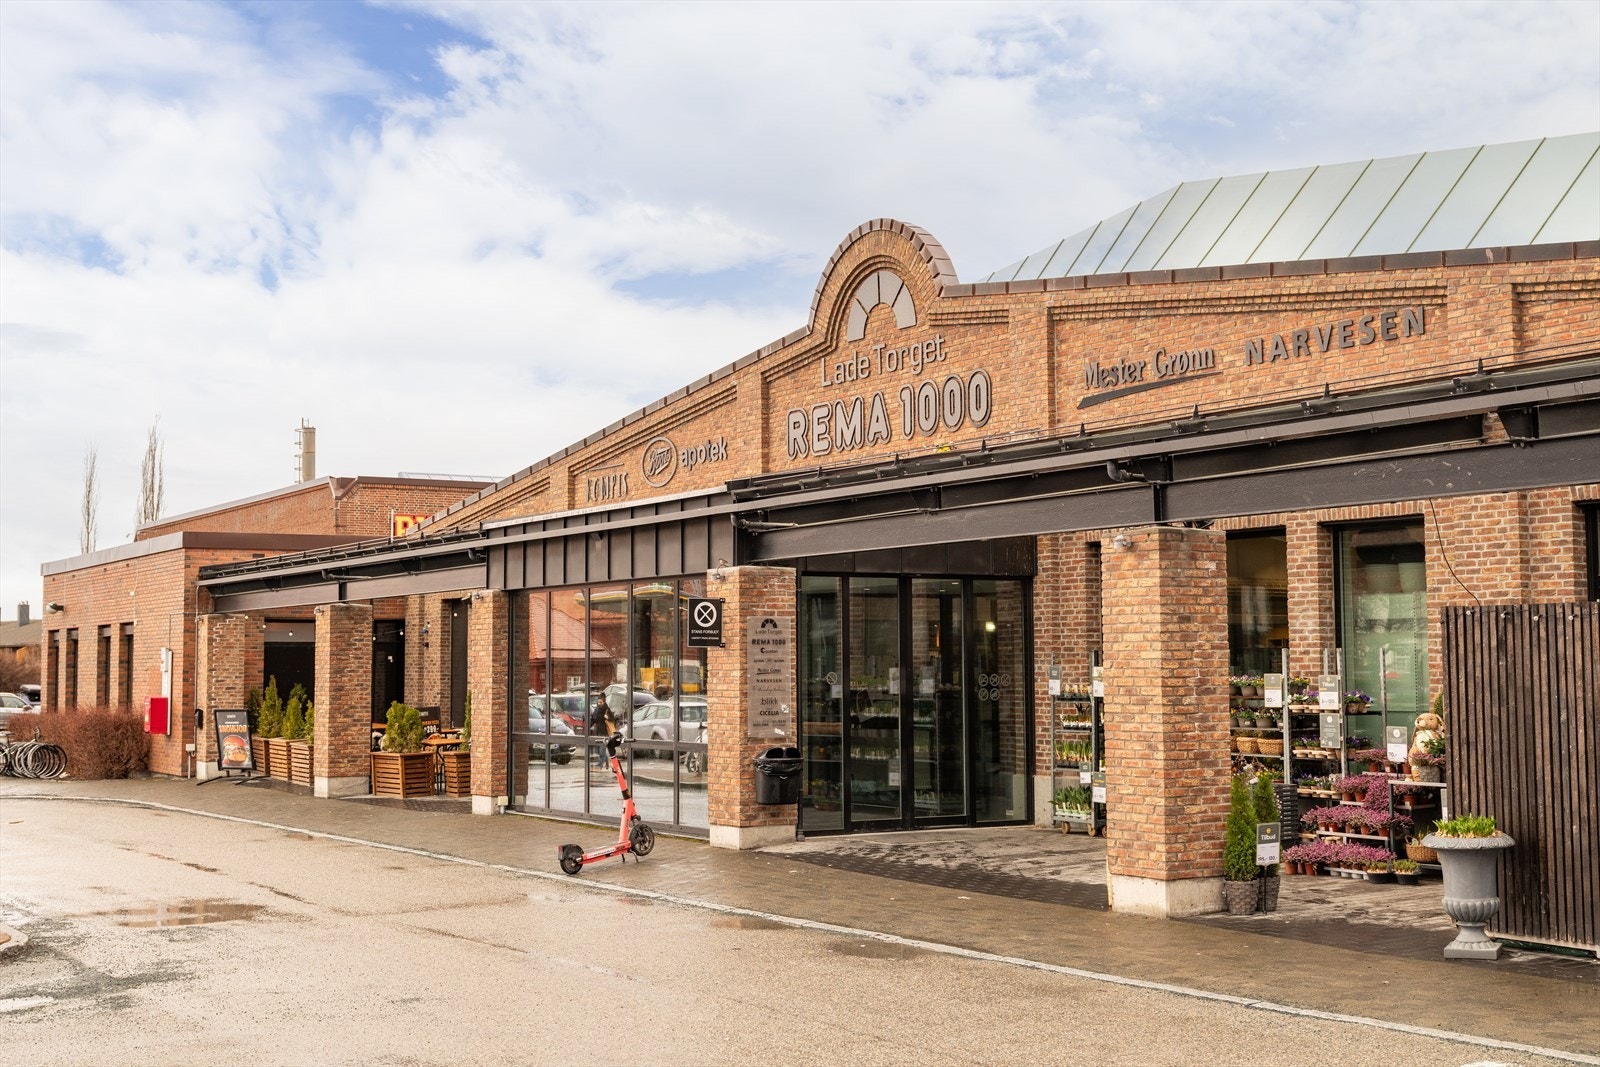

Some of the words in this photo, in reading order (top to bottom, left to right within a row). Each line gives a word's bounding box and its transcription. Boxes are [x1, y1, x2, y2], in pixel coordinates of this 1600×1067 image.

[821, 351, 870, 387] Lade
[873, 335, 947, 375] Torget
[1245, 306, 1424, 366] NARVESEN
[1085, 358, 1146, 390] Mester
[1152, 347, 1215, 379] Grønn
[787, 391, 891, 460] REMA
[899, 368, 992, 440] 1000
[681, 437, 728, 471] apotek
